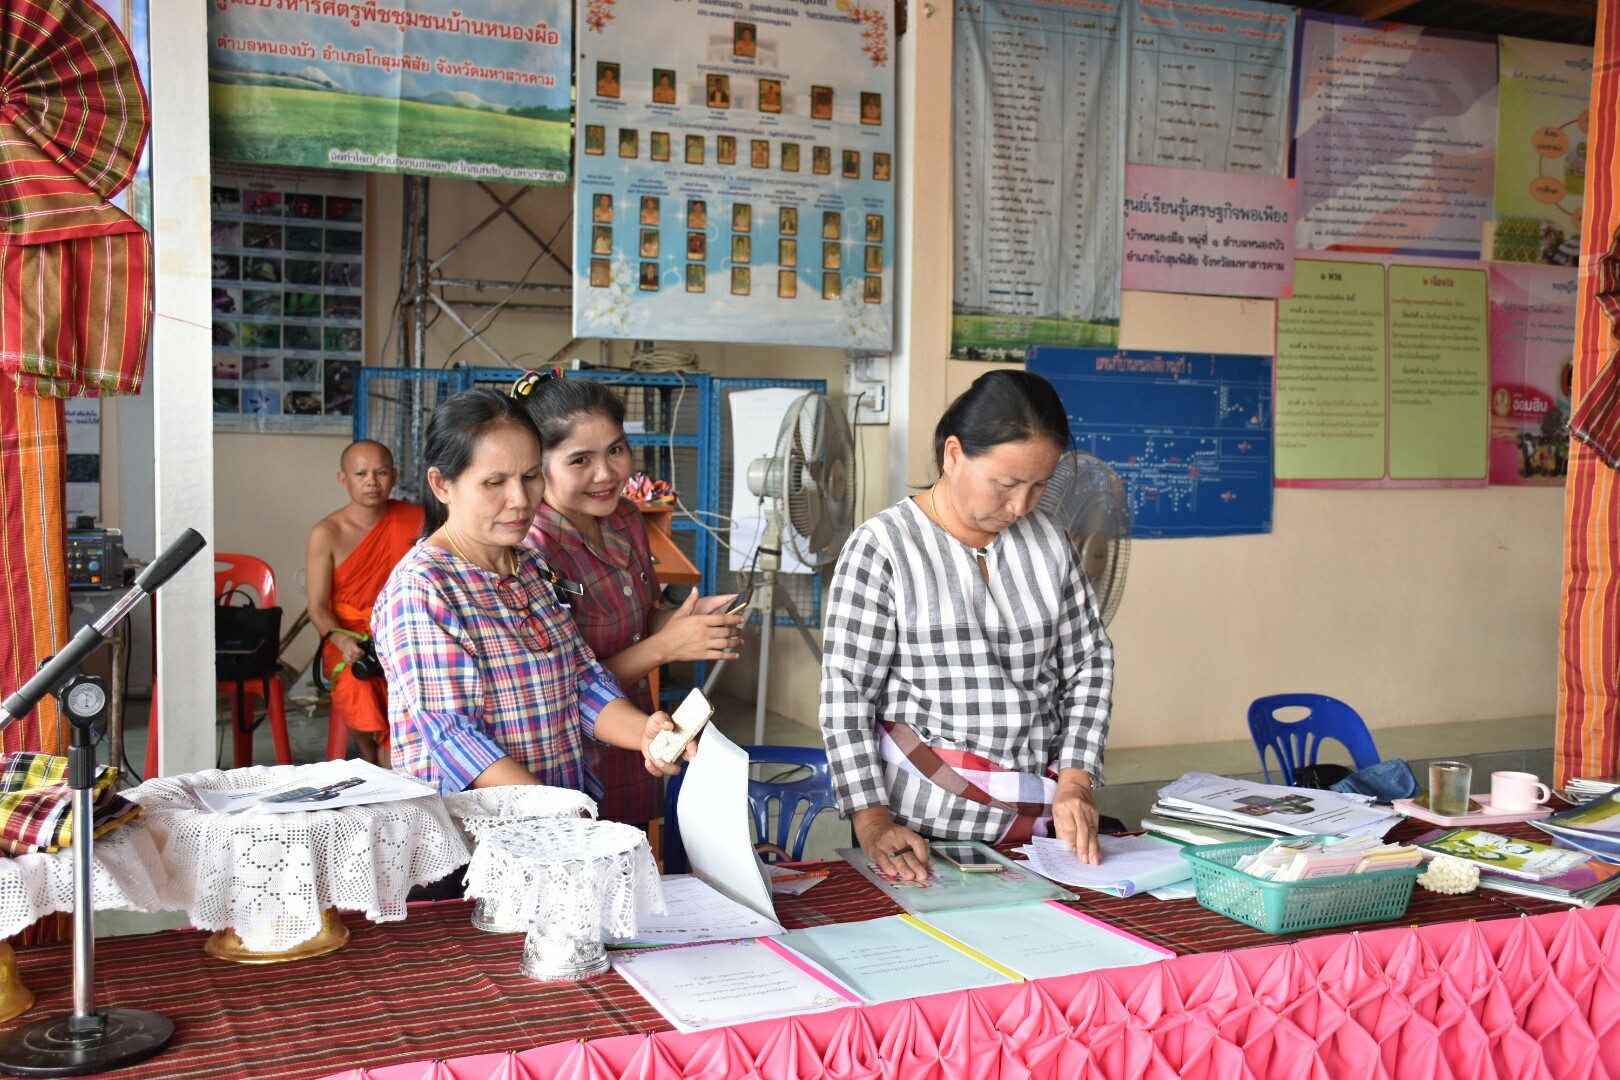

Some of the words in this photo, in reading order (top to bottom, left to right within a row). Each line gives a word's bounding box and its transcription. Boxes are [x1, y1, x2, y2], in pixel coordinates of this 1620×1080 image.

[217, 34, 316, 58] ตำบลหนองบัว
[323, 45, 431, 73] อำเภอโกสุมพิสัย
[436, 59, 555, 87] จังหวัดมหาสารคาม
